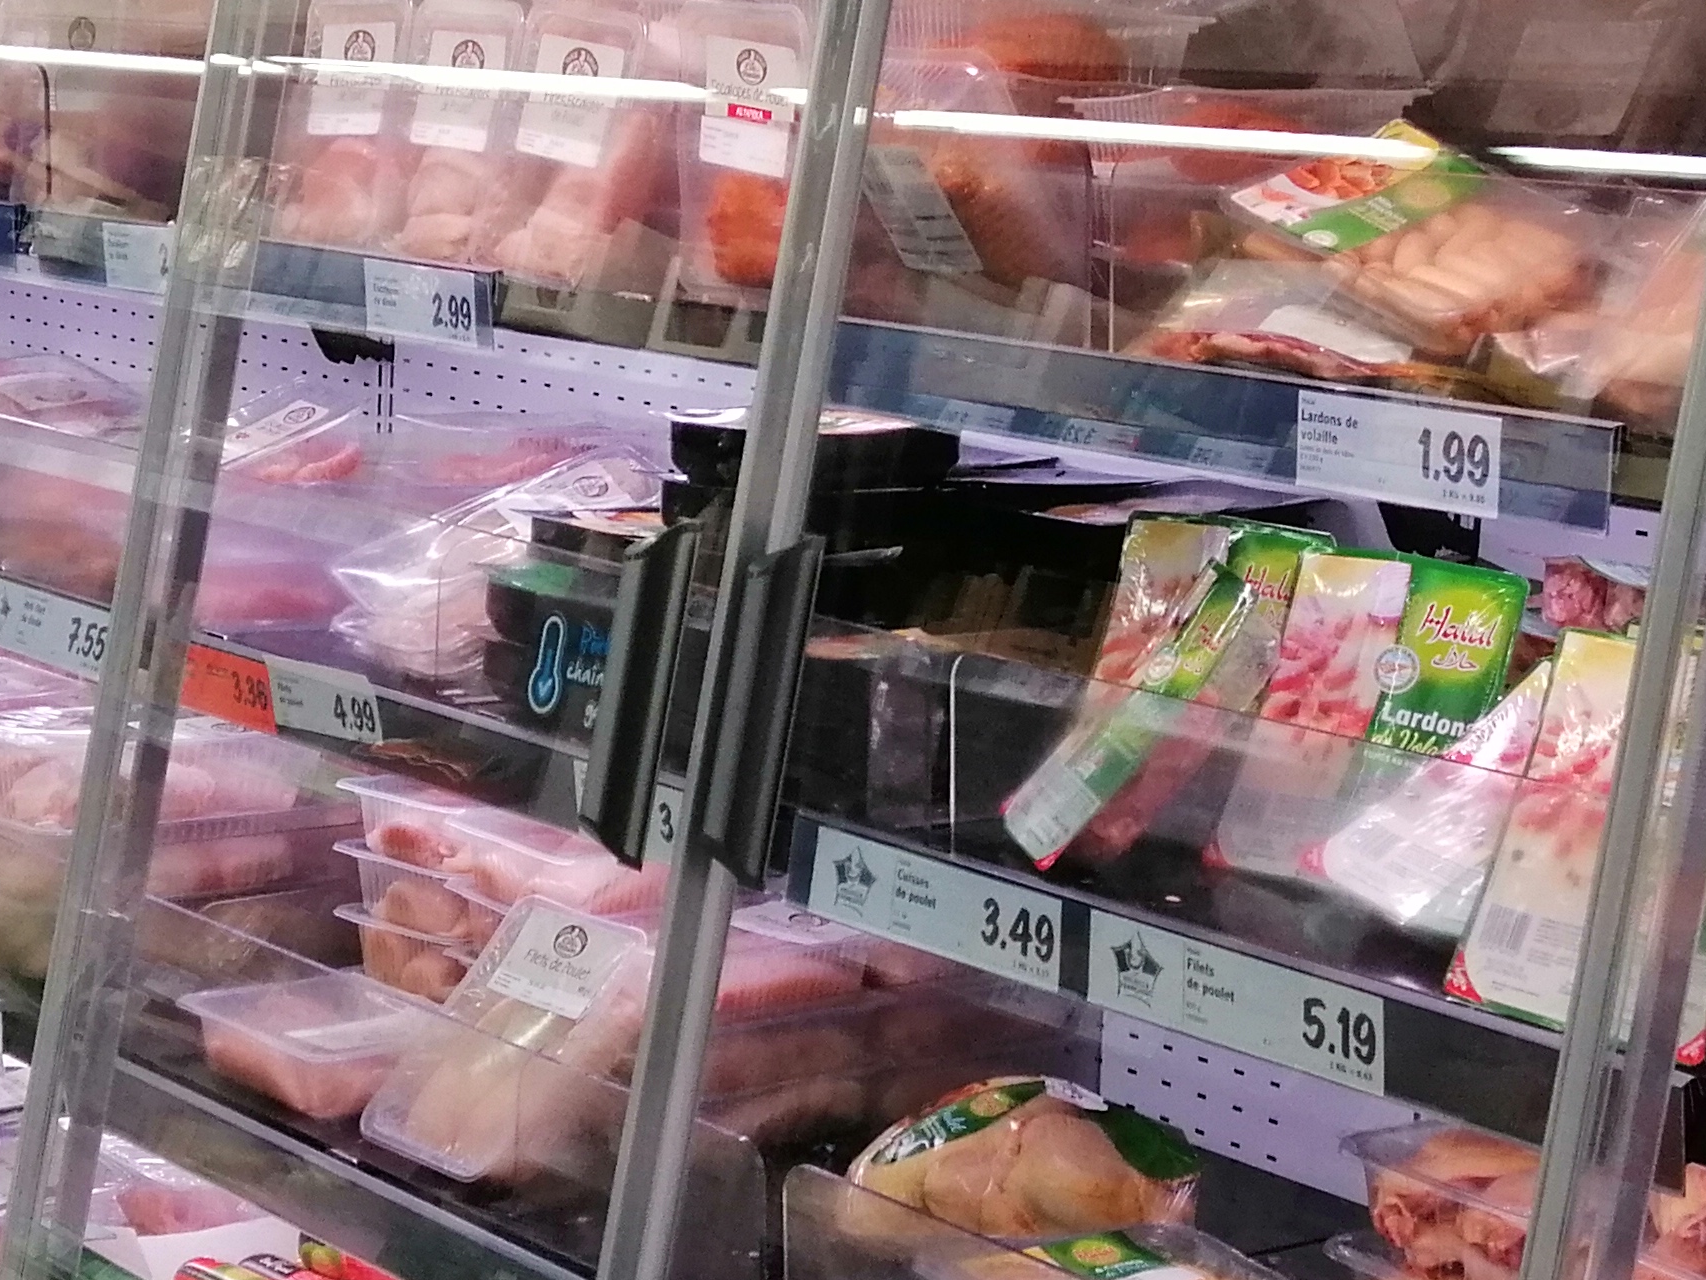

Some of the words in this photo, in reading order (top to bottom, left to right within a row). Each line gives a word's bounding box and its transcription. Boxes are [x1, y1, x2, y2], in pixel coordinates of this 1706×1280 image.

[432, 292, 472, 331] 2.99
[1301, 409, 1342, 427] Lardons
[1345, 416, 1358, 429] de
[1301, 428, 1338, 445] volaille
[1418, 427, 1490, 488] 1.99
[68, 616, 109, 661] 7.55
[1416, 601, 1502, 649] Halal
[333, 693, 376, 733] 4.99
[895, 887, 906, 900] de
[908, 893, 937, 910] poulet
[981, 898, 1055, 963] 3.49
[524, 948, 548, 968] Filets
[549, 959, 563, 971] de
[1186, 957, 1215, 978] Filets
[1186, 977, 1200, 992] de
[1202, 984, 1235, 1005] poulet
[1302, 997, 1376, 1065] 5.19
